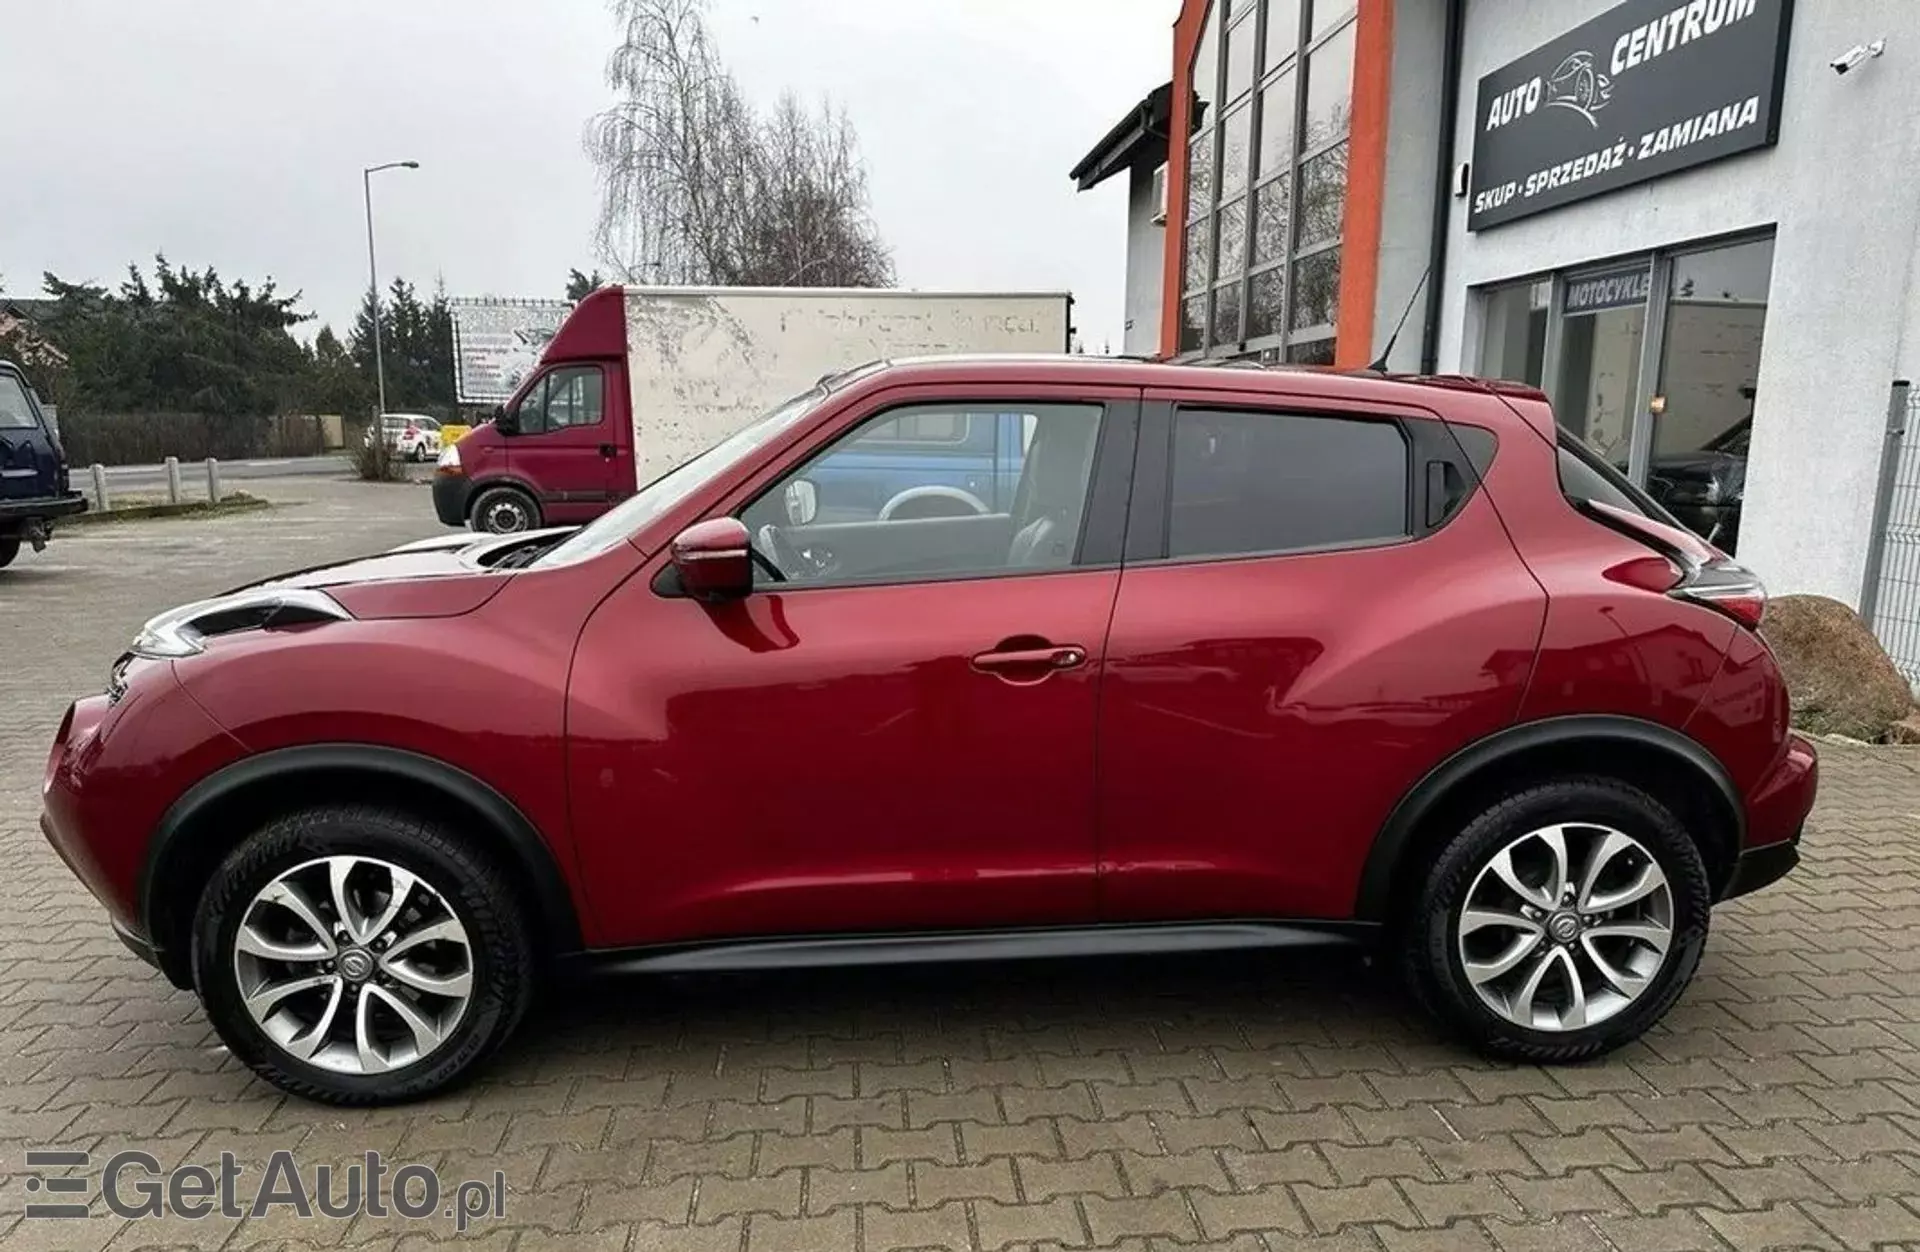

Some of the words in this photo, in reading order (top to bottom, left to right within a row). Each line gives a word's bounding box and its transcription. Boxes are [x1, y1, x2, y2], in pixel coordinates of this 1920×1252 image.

[1486, 76, 1542, 131] AUTO
[1474, 181, 1517, 214] SKUP
[1524, 136, 1627, 198] SPRZEDAŻ
[1637, 96, 1761, 161] ZAMIANA
[1567, 272, 1650, 308] MOTOCYKLE
